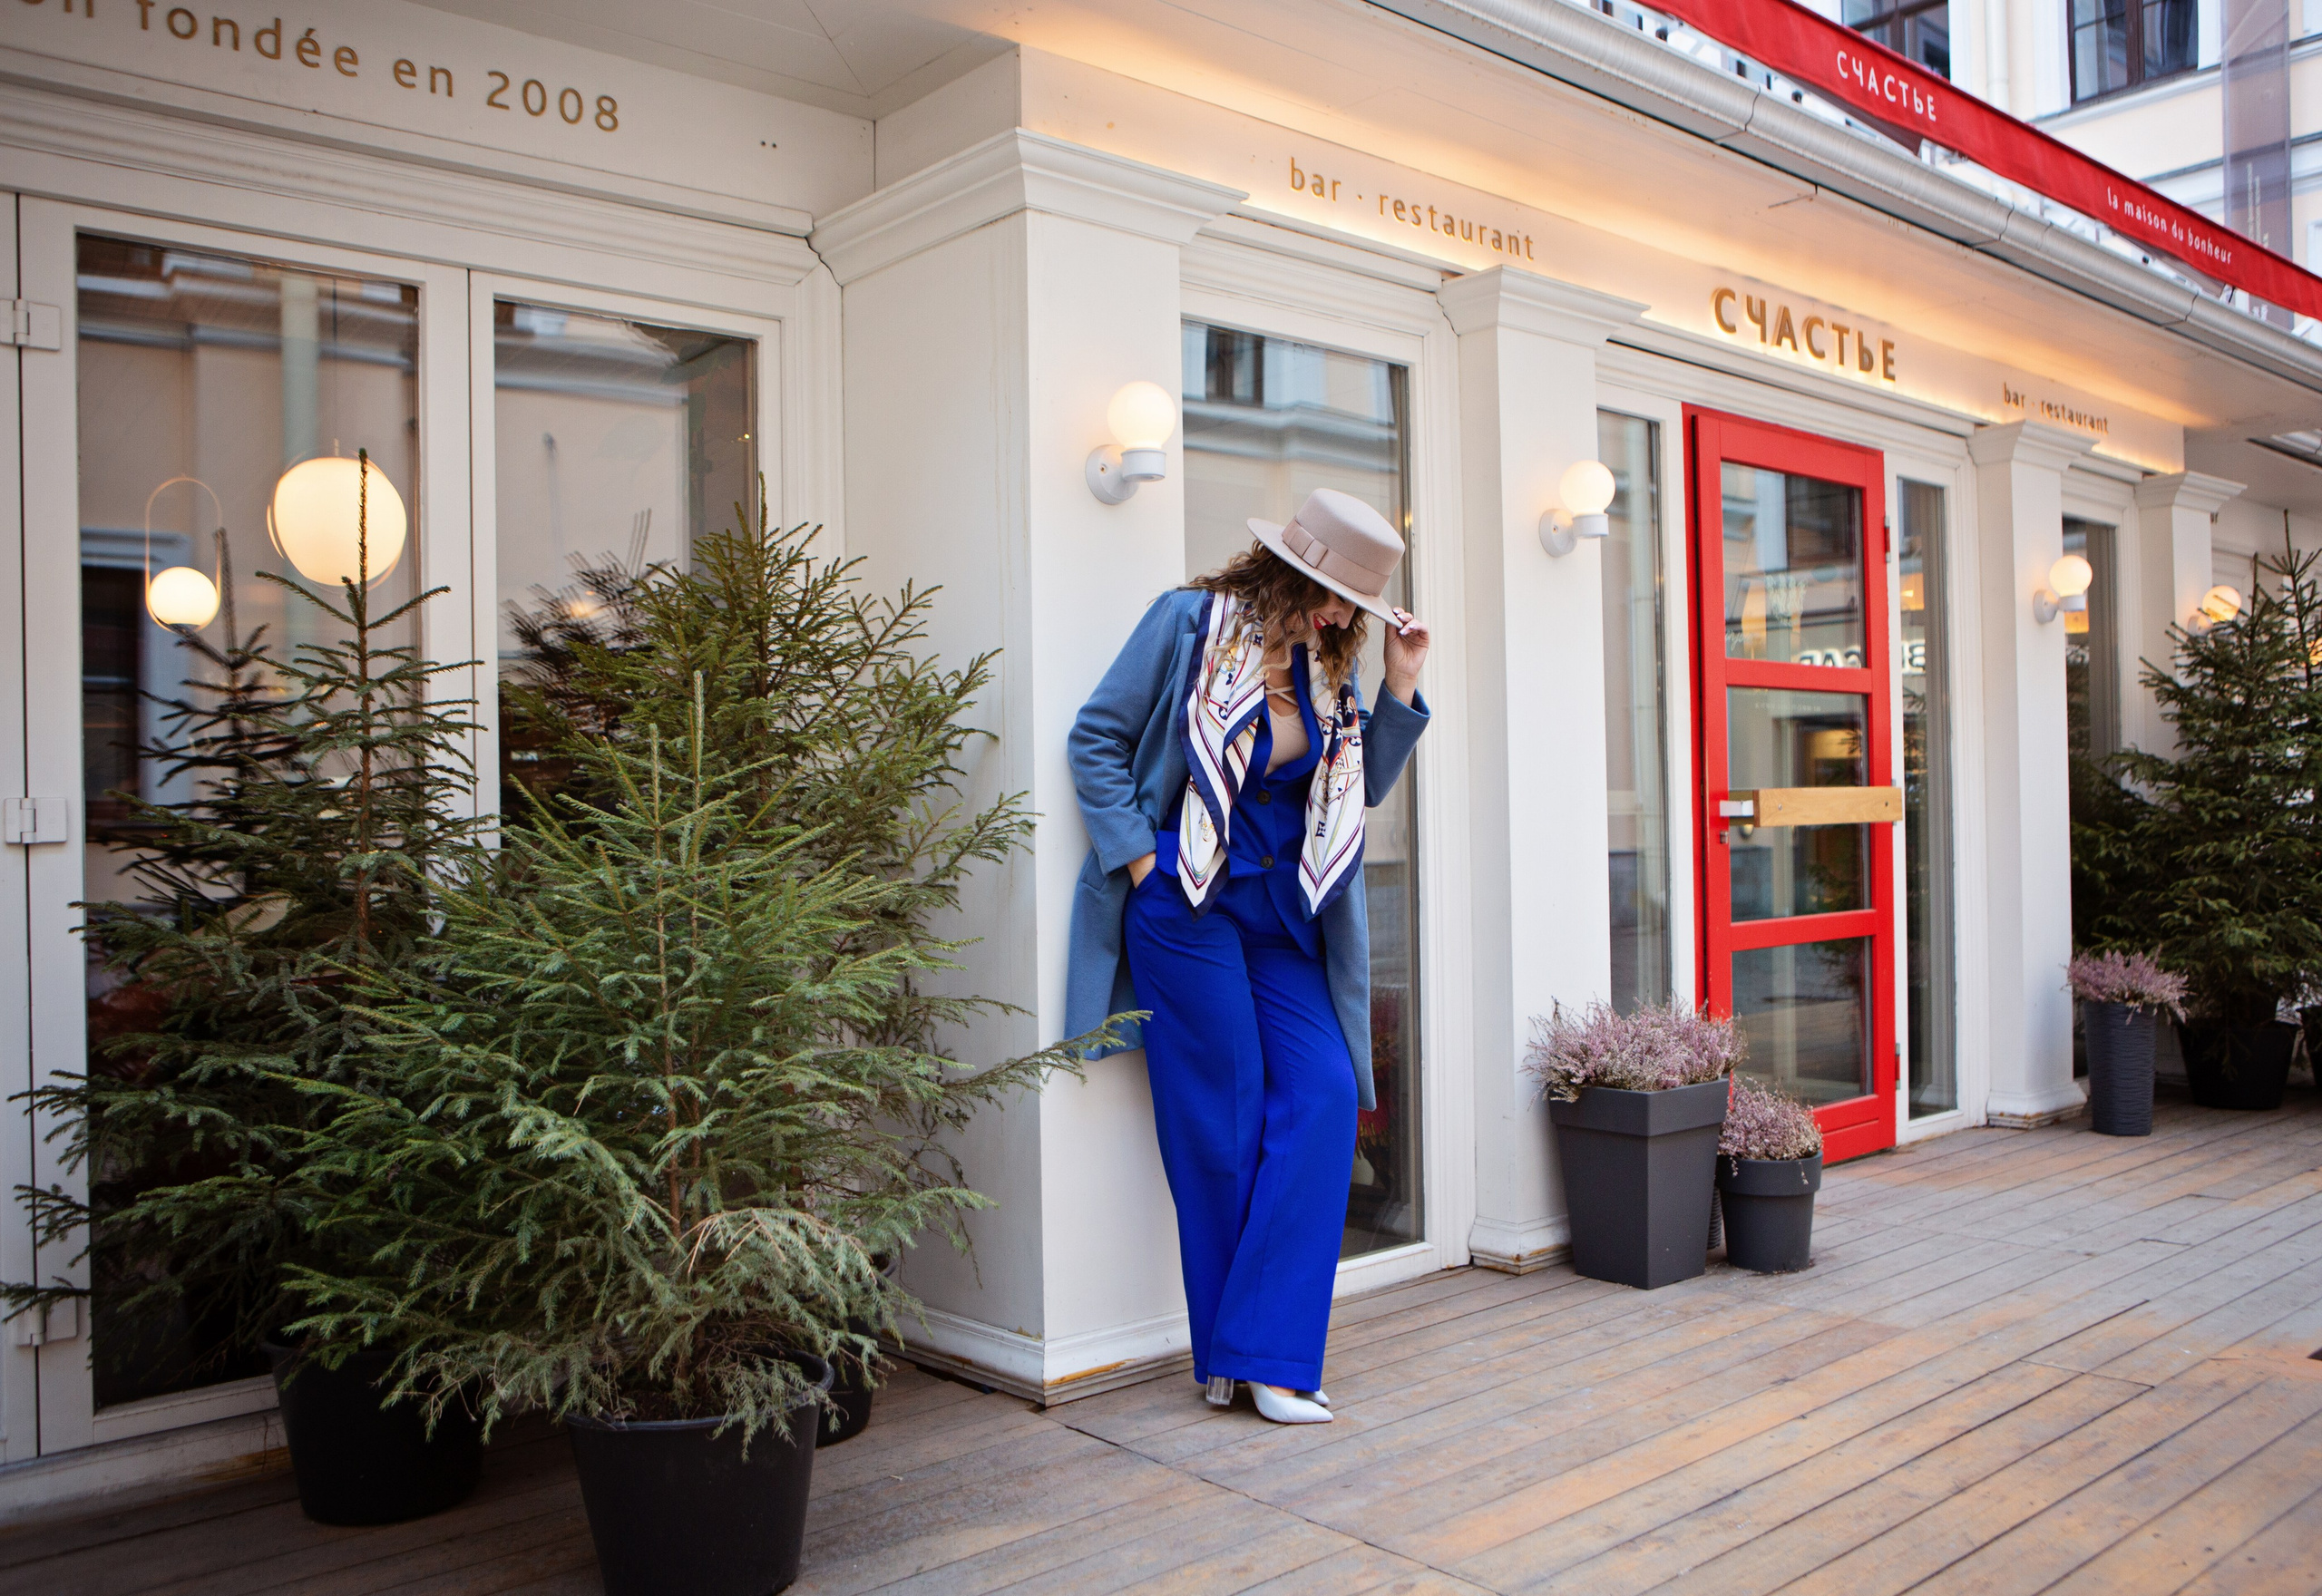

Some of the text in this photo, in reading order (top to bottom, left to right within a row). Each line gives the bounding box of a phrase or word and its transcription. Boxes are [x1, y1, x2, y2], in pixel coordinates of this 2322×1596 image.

[392, 58, 454, 98] en
[486, 71, 620, 133] 2008
[1837, 50, 1937, 122] СЧАСТЬЕ
[1290, 156, 1535, 261] bar restaurant
[2124, 200, 2168, 233] maison
[2171, 219, 2184, 243] du
[2187, 227, 2232, 266] bonheur
[1712, 287, 1897, 383] СЧАСТЬЕ
[2003, 381, 2109, 435] bar restaurant
